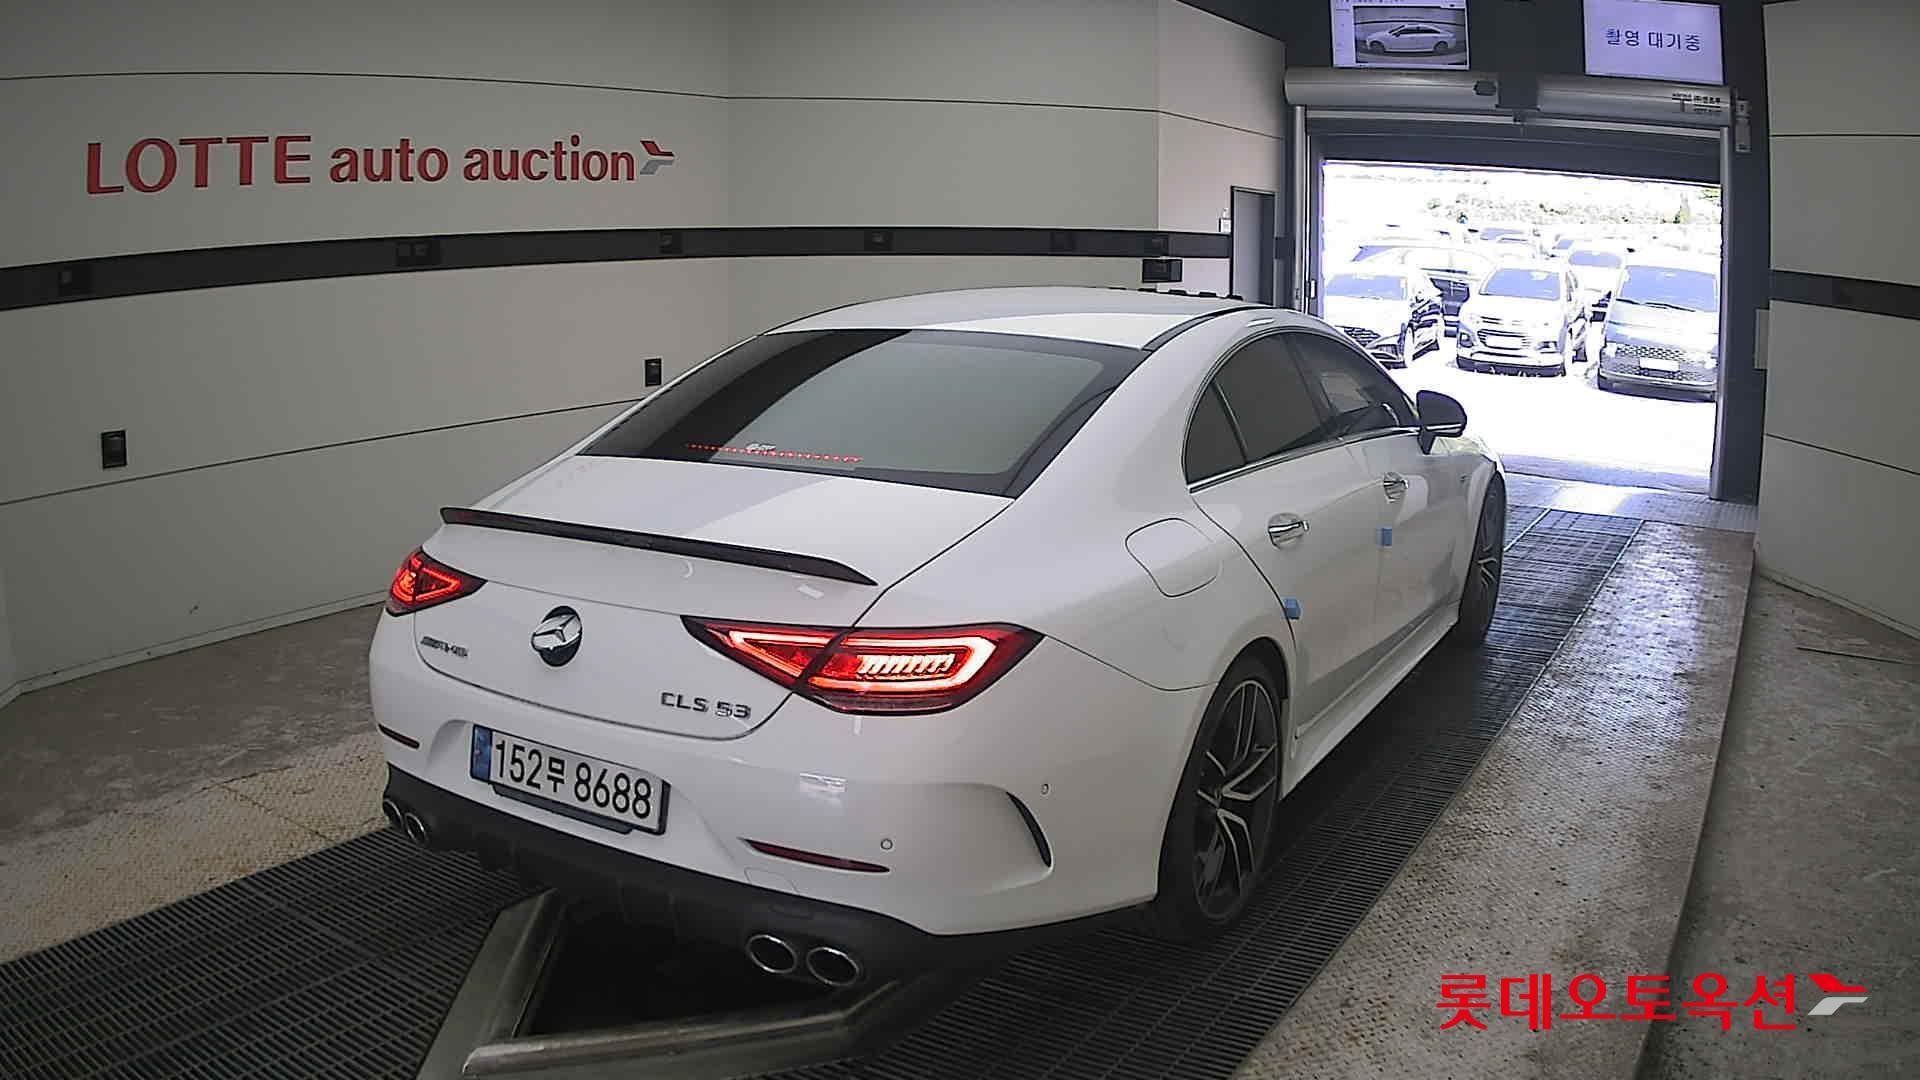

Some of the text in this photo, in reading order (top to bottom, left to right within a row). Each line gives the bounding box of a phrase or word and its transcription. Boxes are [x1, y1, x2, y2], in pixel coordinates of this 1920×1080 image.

[1648, 31, 1701, 52] 대기중
[88, 135, 636, 194] LOTTE auto auction
[661, 692, 751, 719] CLS 53
[496, 740, 651, 819] 152무 8688
